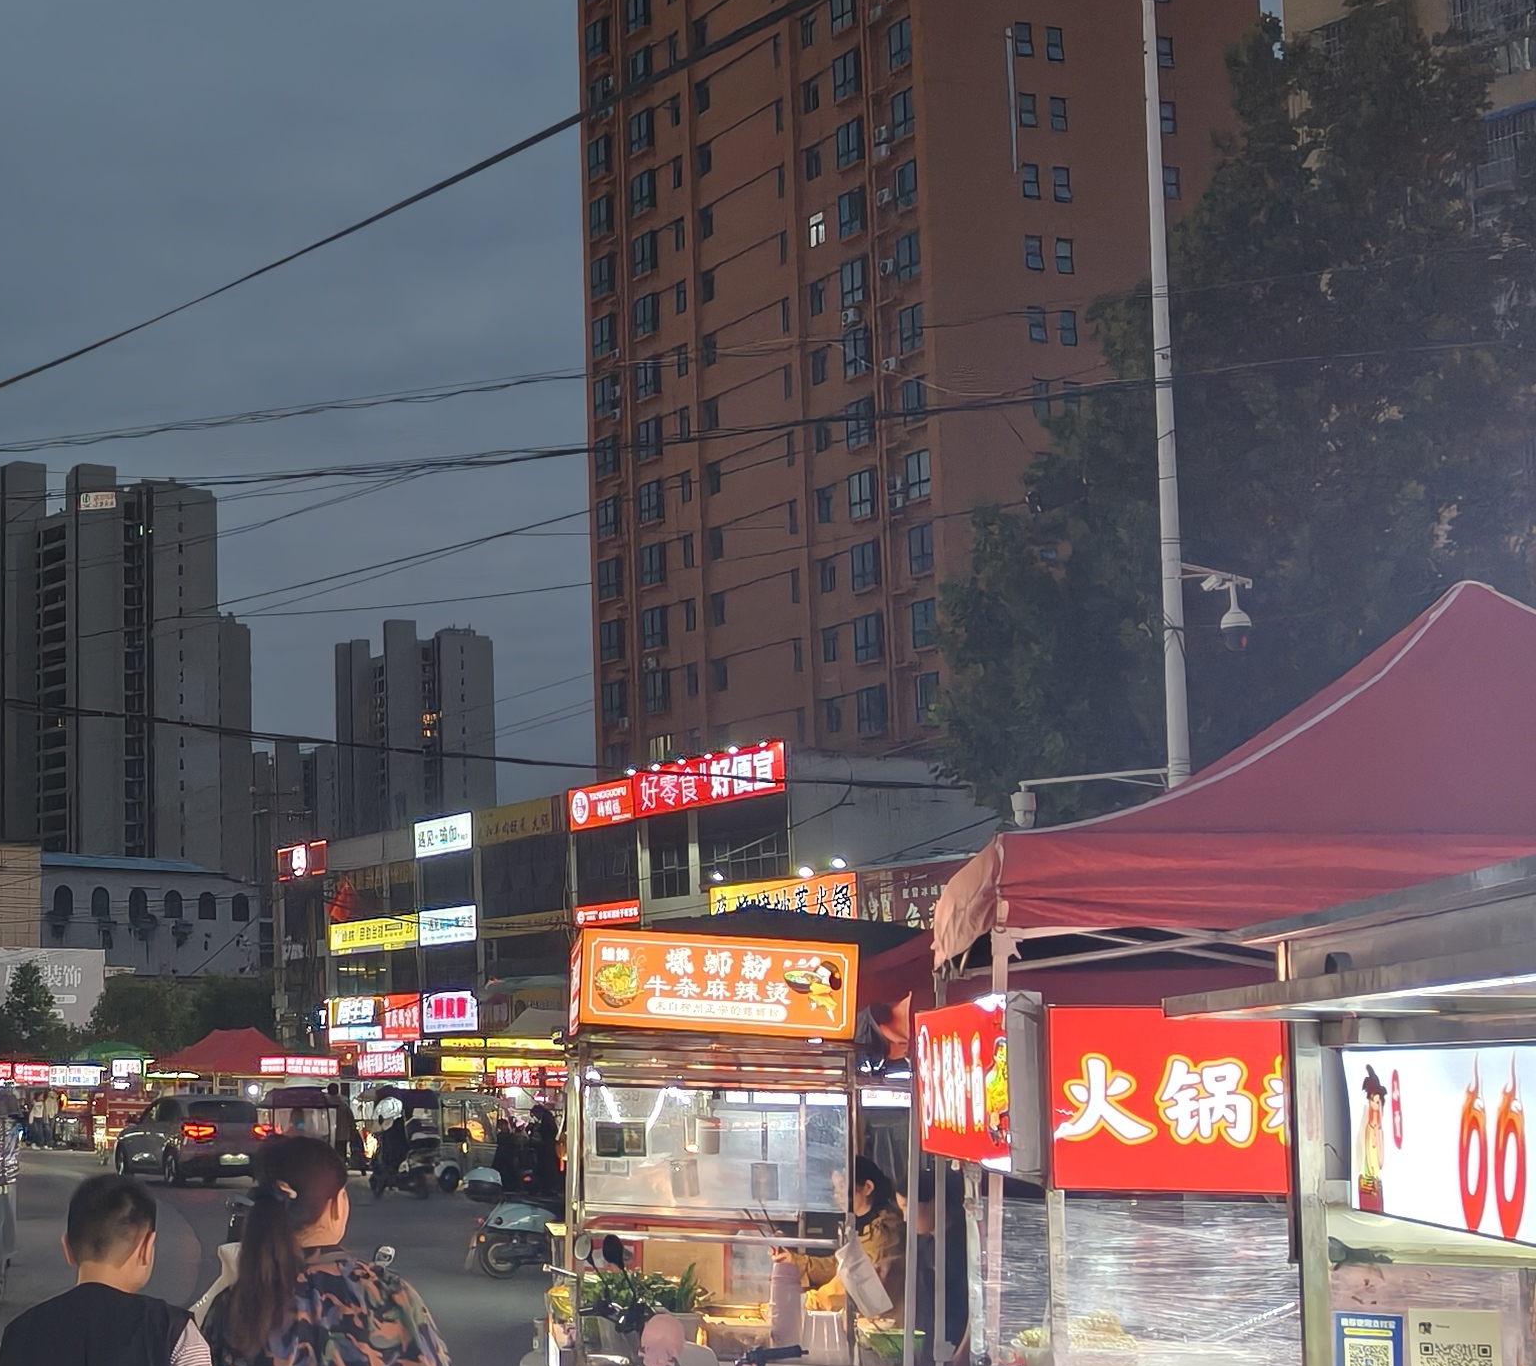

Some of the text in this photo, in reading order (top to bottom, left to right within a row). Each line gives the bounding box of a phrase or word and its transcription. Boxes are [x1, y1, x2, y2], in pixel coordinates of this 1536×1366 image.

[711, 751, 775, 798] 好便宜
[665, 947, 772, 980] 螺蛳粉
[643, 975, 792, 1005] 牛杂麻辣烫
